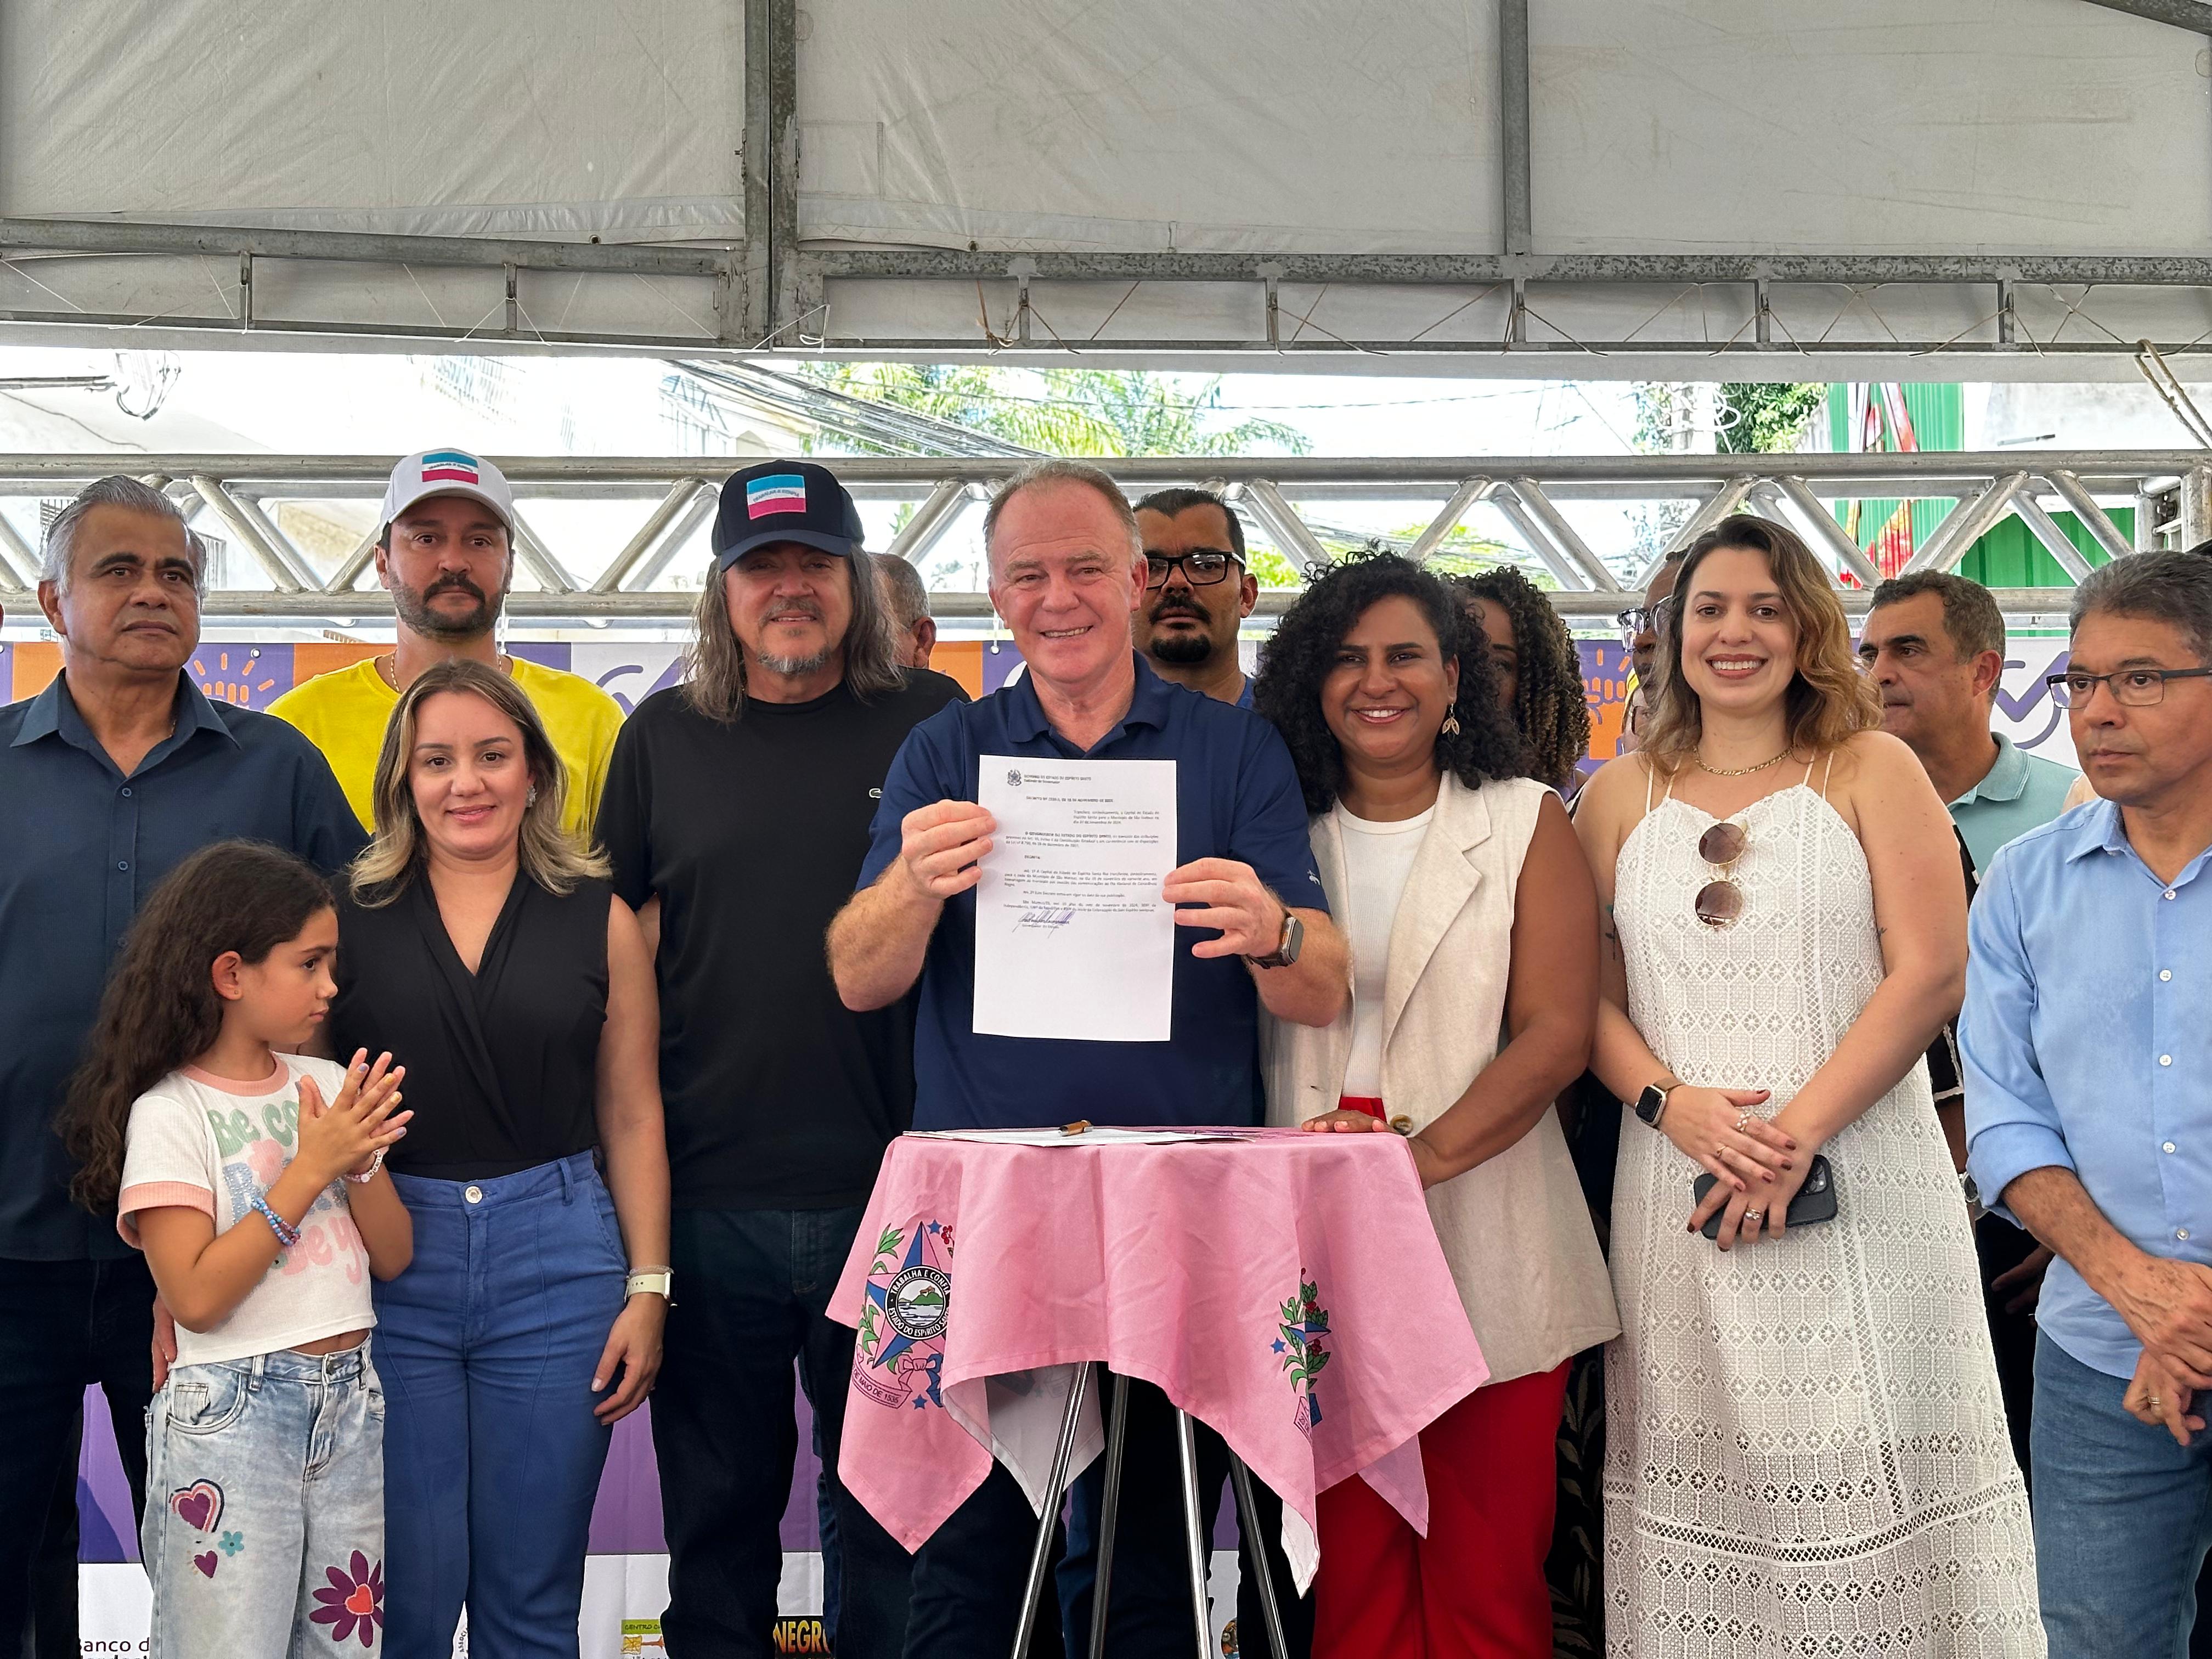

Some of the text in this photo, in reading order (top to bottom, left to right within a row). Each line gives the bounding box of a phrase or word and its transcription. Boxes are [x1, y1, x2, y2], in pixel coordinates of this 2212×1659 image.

[890, 1269, 922, 1294] TRABALHA
[930, 1272, 951, 1295] CONFIA
[888, 1307, 905, 1330] ESTADO
[903, 1325, 913, 1335] DO
[859, 1376, 873, 1391] MAIO
[872, 1388, 883, 1398] DE
[884, 1393, 899, 1403] 1535
[80, 1641, 131, 1652] anco
